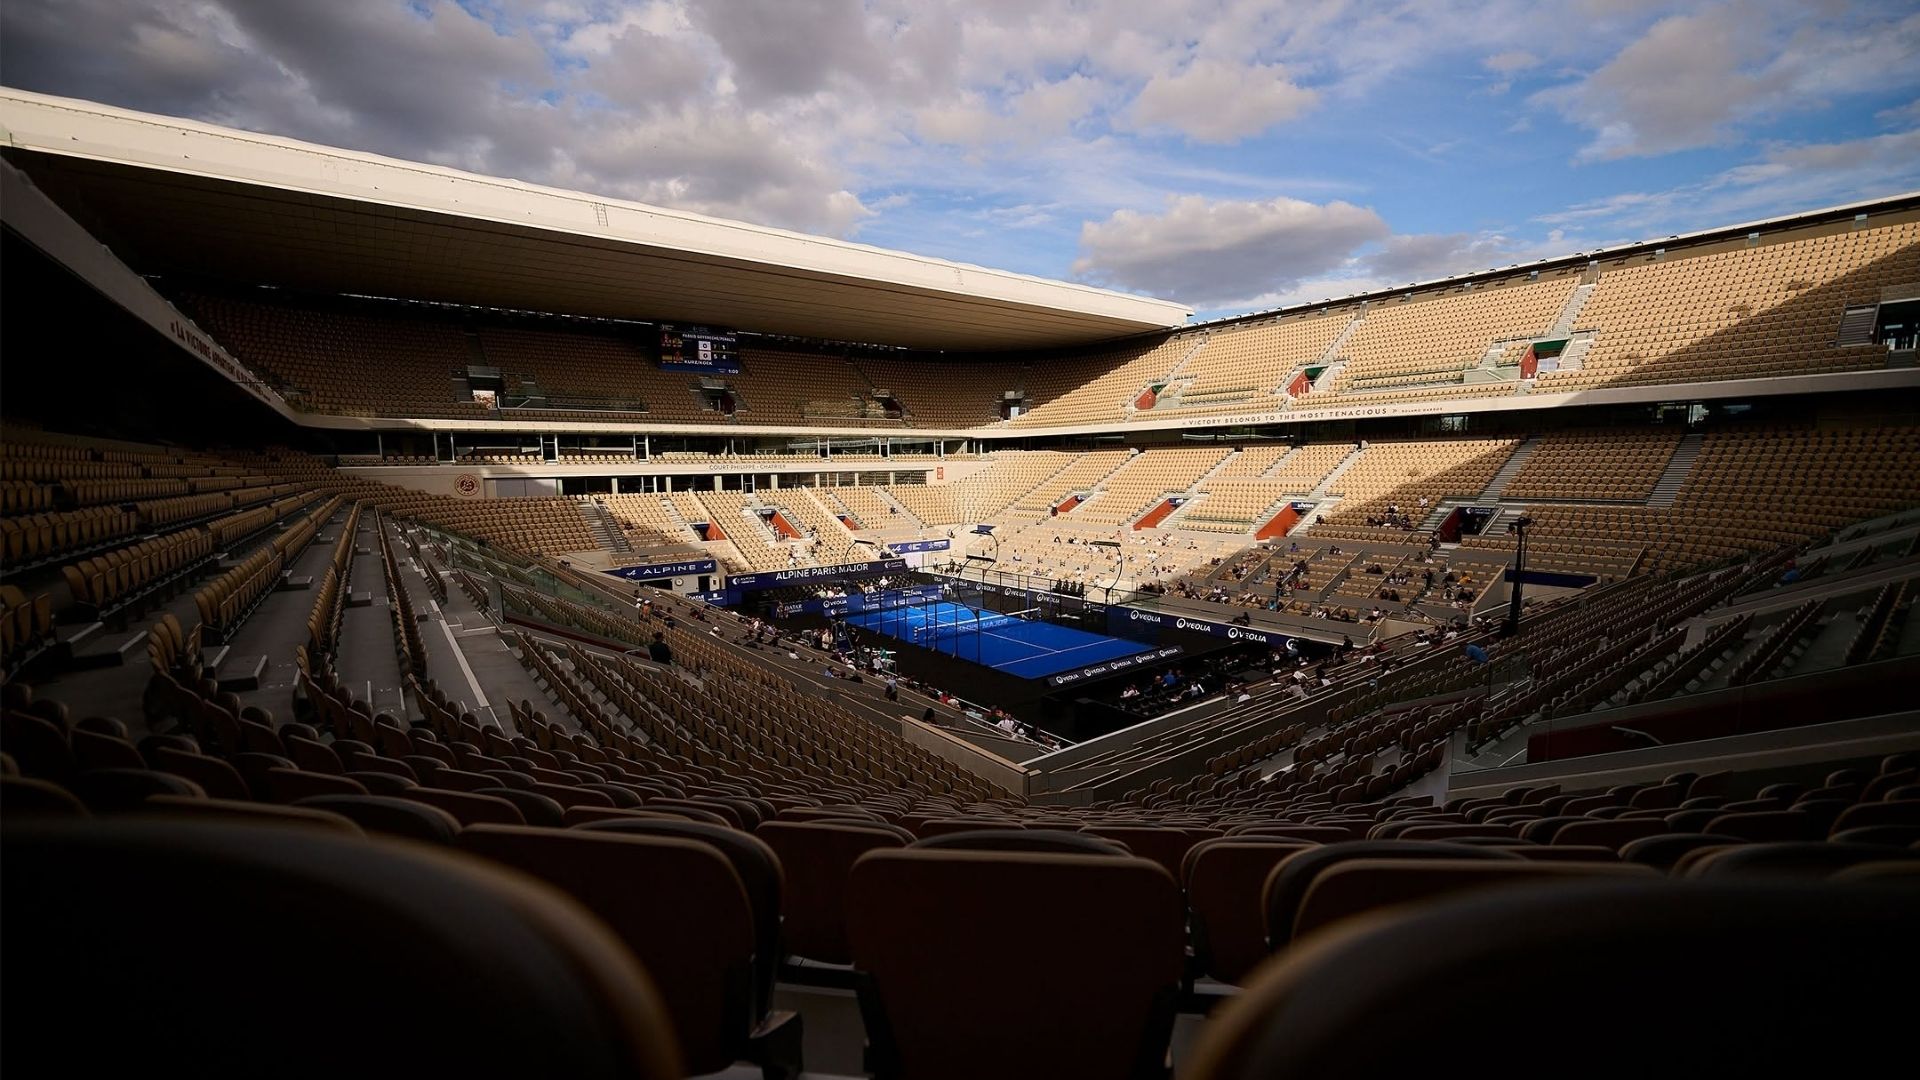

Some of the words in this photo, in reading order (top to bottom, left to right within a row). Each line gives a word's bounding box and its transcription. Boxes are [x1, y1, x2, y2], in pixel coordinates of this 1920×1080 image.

[1329, 408, 1388, 418] TENACIOUS
[643, 565, 696, 575] ALPINE
[776, 568, 810, 580] ALPINE
[811, 566, 837, 577] PARIS
[838, 563, 869, 573] MAJOR
[1139, 613, 1161, 623] VEOLIA
[1186, 622, 1211, 633] VEOLIA
